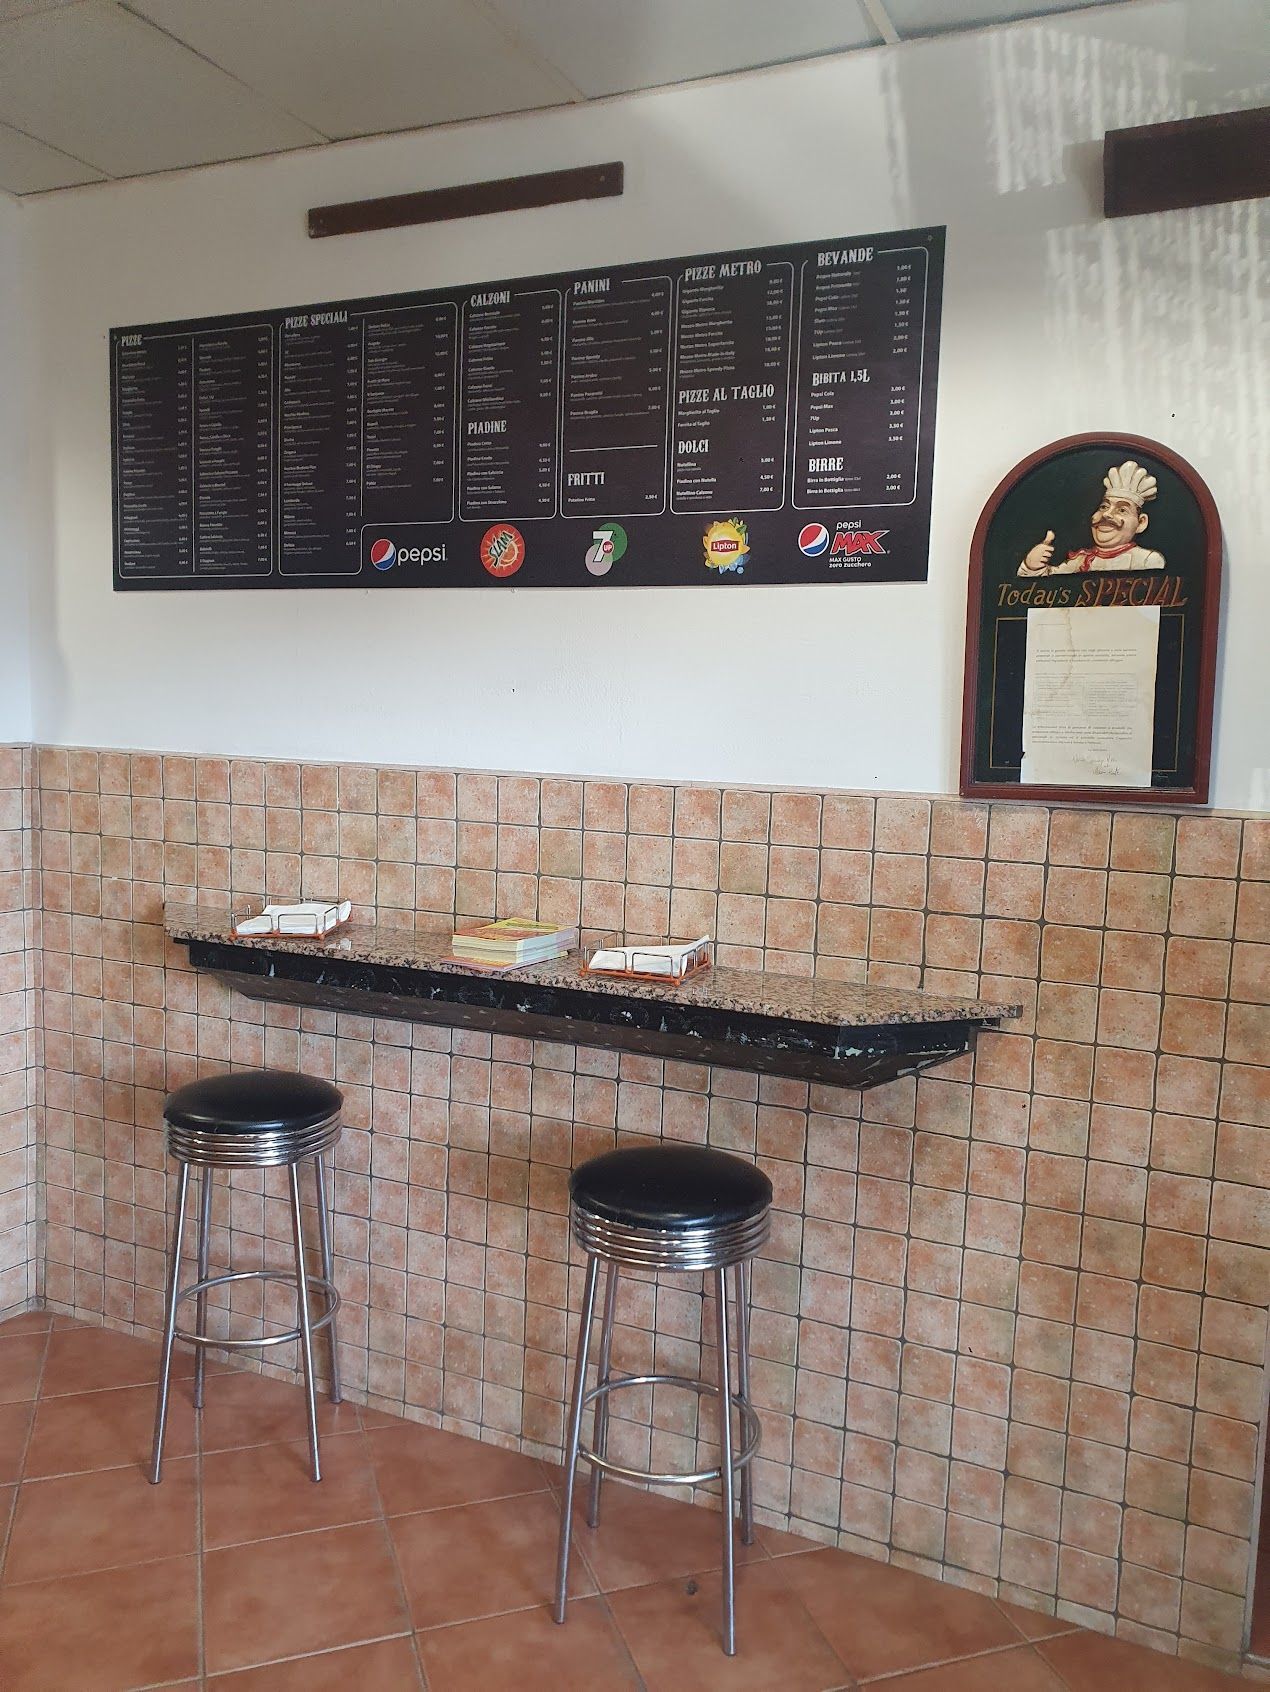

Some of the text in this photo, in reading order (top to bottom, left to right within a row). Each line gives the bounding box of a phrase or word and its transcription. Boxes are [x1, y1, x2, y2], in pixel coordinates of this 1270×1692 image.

[817, 247, 874, 267] BEVANDE
[684, 260, 762, 282] PIZZE METRO
[573, 278, 611, 295] PANINI
[470, 291, 511, 307] CALZONI
[285, 310, 348, 330] PIZZE SPECIALI
[121, 334, 143, 347] PIZZE
[812, 371, 846, 387] BIBITA
[678, 384, 775, 405] PIZZE AL TAGLIO
[468, 420, 508, 436] PIADINE
[678, 439, 709, 455] DOLCI
[808, 457, 844, 473] BIRRE
[568, 472, 605, 488] FRITTI
[836, 522, 861, 530] pepsi
[712, 541, 738, 553] Lipton
[830, 530, 890, 557] MAX
[398, 544, 446, 566] pepsi
[997, 575, 1188, 608] Today's SPECIAL
